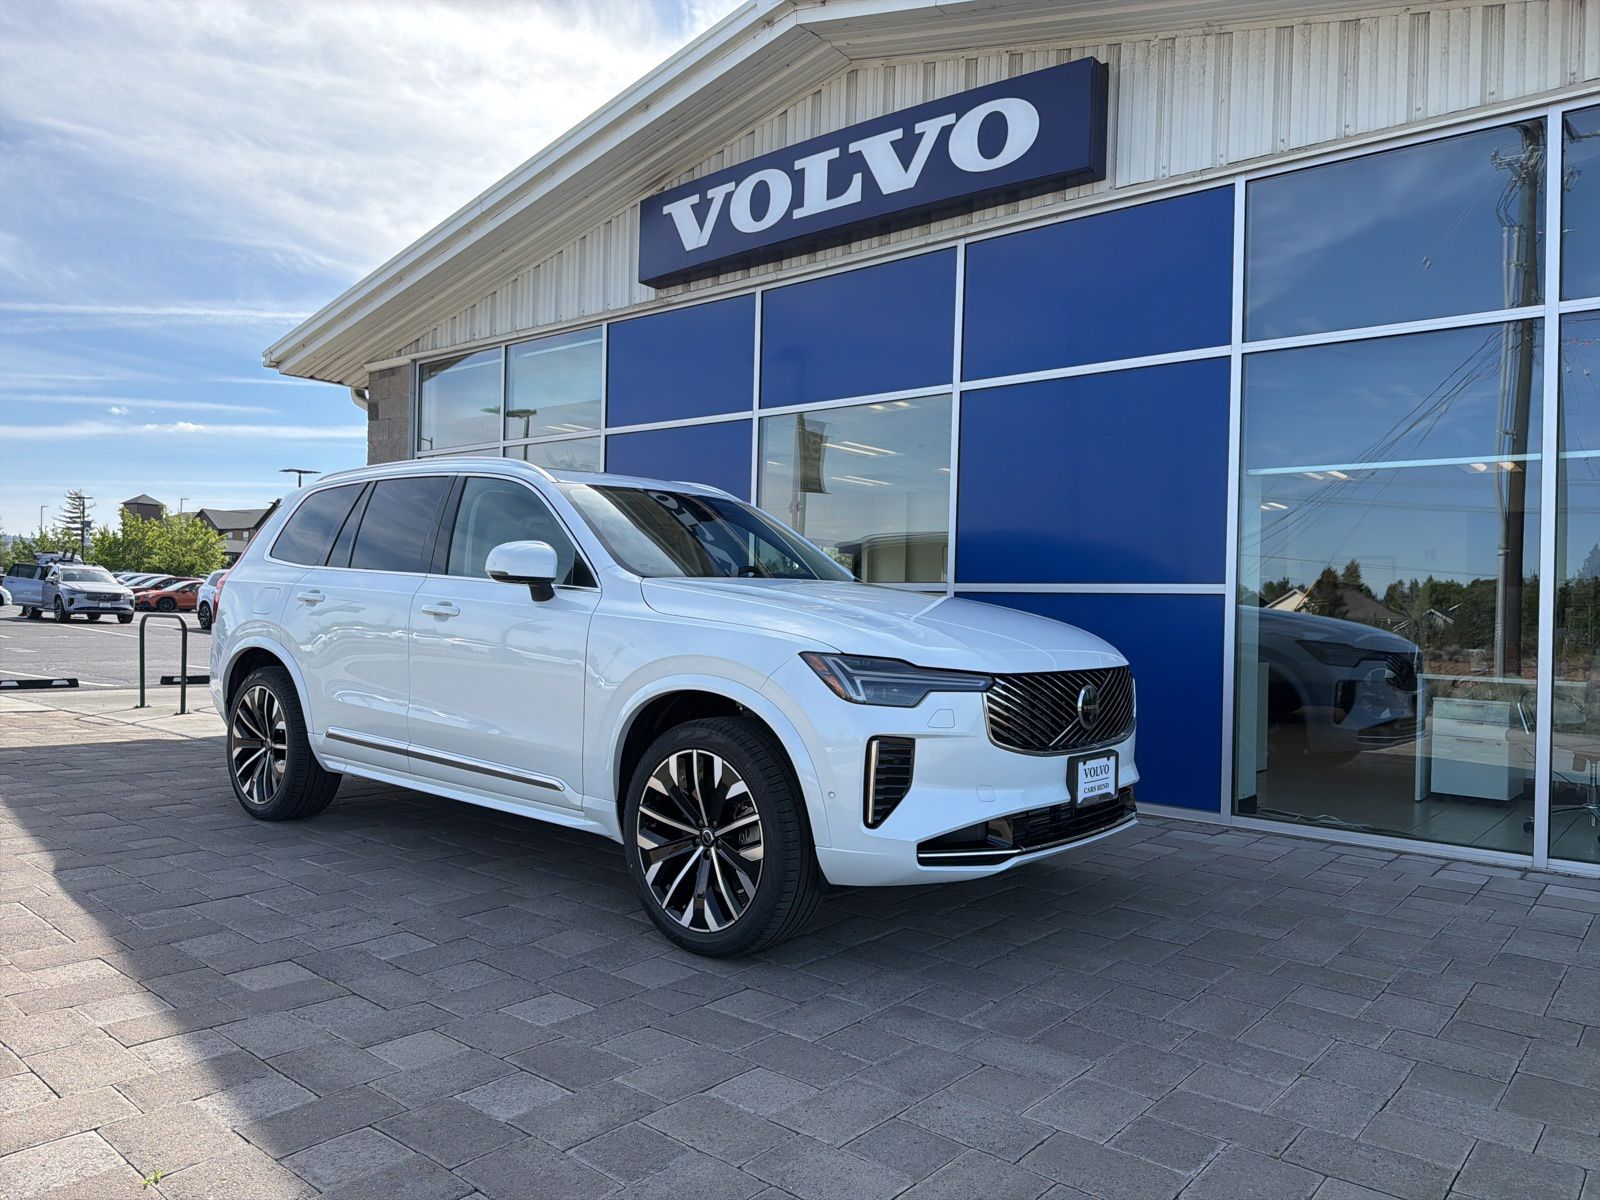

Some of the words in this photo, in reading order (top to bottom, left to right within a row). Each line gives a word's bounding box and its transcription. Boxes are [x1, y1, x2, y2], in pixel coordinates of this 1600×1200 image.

[662, 97, 1040, 252] VOLVO
[1084, 764, 1109, 778] VOLVO
[1084, 785, 1097, 794] CARS
